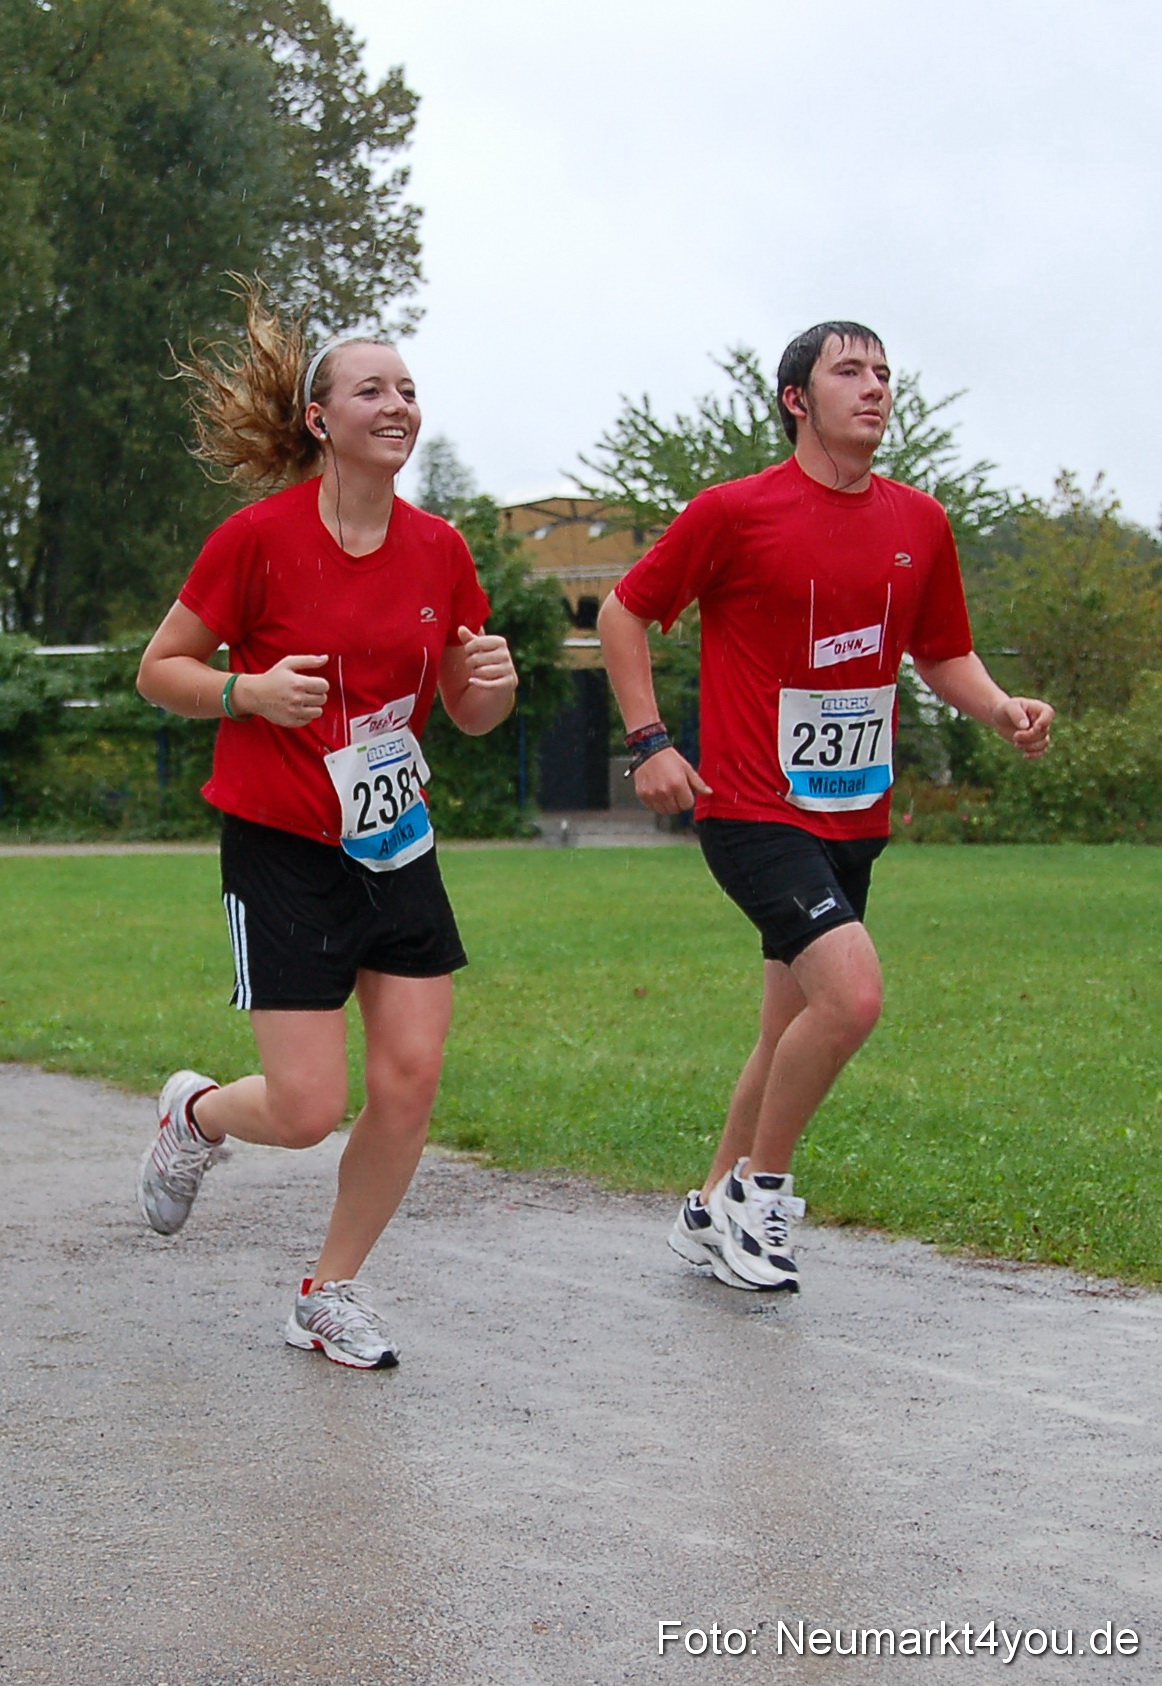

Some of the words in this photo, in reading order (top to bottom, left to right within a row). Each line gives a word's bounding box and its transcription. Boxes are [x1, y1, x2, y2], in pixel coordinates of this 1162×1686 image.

[834, 638, 863, 655] DEHN
[821, 697, 869, 711] BOCK
[366, 738, 406, 763] BOCK
[791, 718, 884, 767] 2377
[808, 774, 867, 795] Michael
[353, 761, 424, 833] 2381
